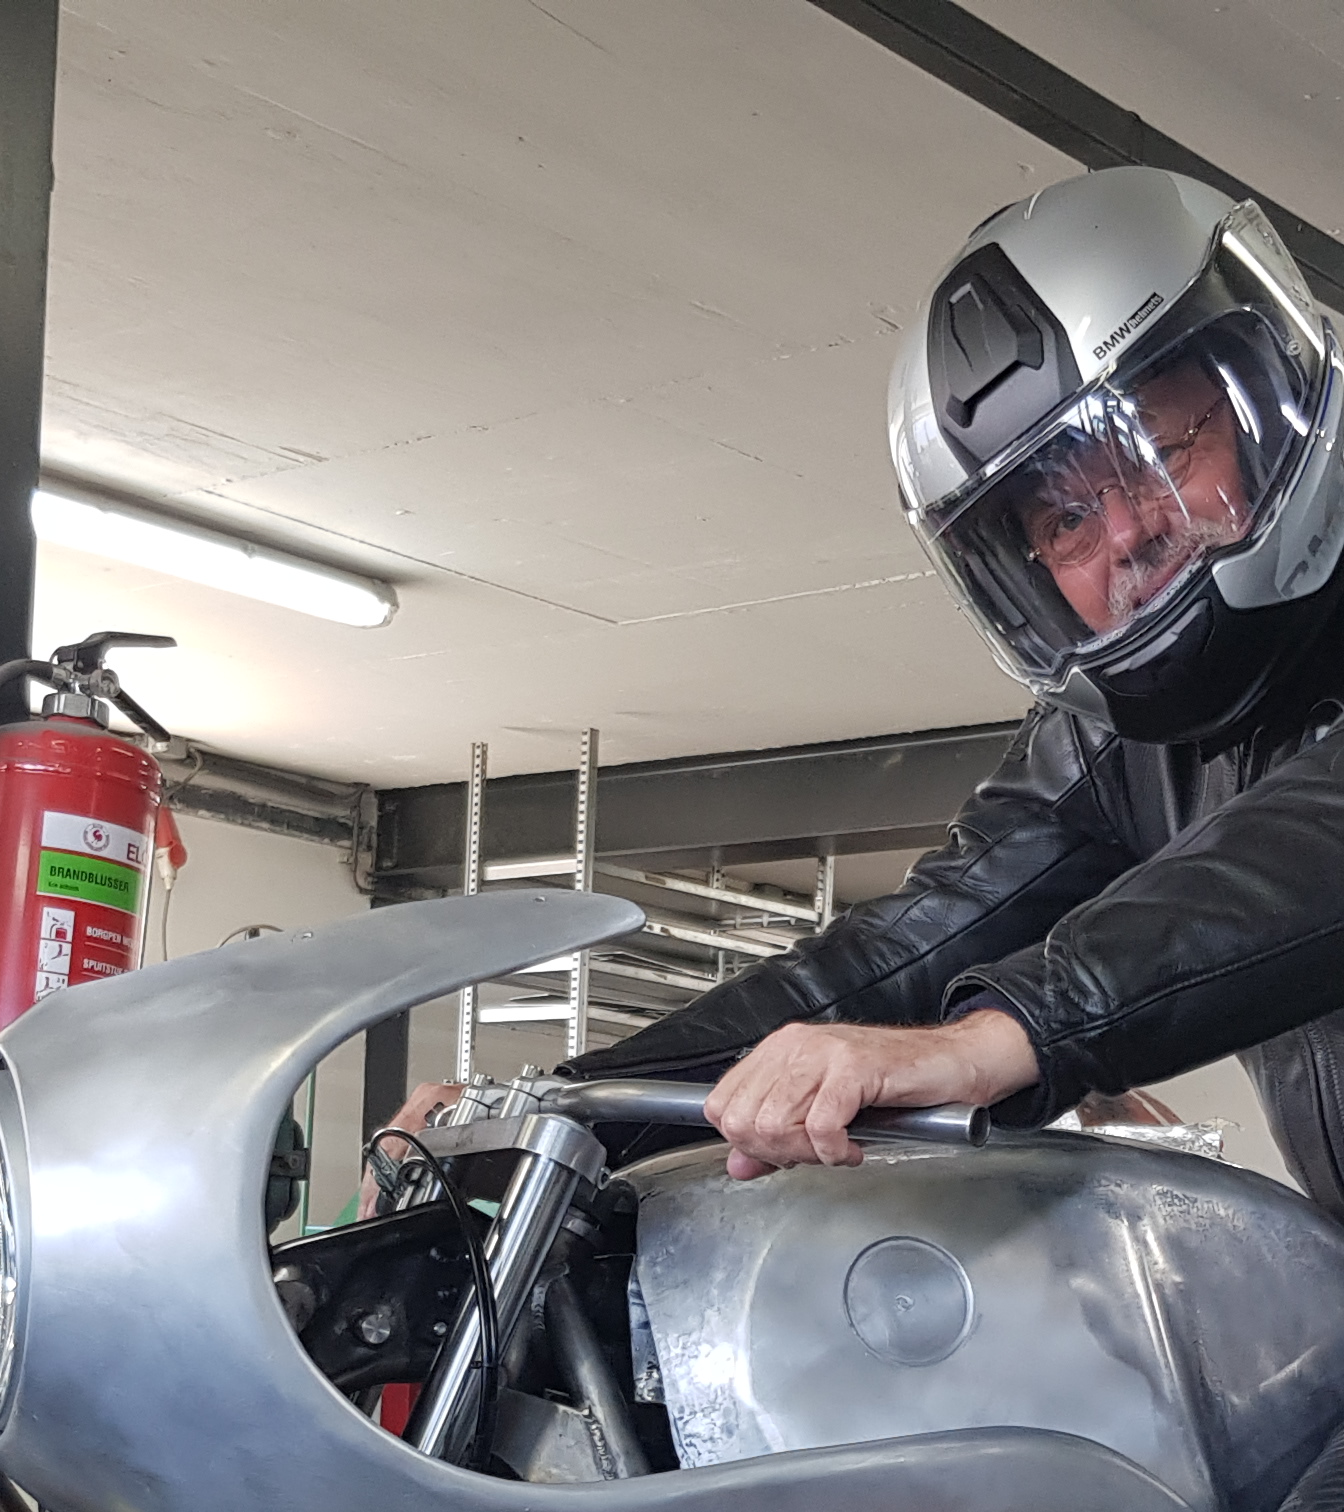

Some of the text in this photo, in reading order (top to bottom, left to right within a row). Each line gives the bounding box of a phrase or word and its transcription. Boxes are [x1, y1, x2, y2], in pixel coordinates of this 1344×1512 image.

[1093, 294, 1164, 361] BMW helmets
[49, 865, 129, 892] BRANDBLUSSER
